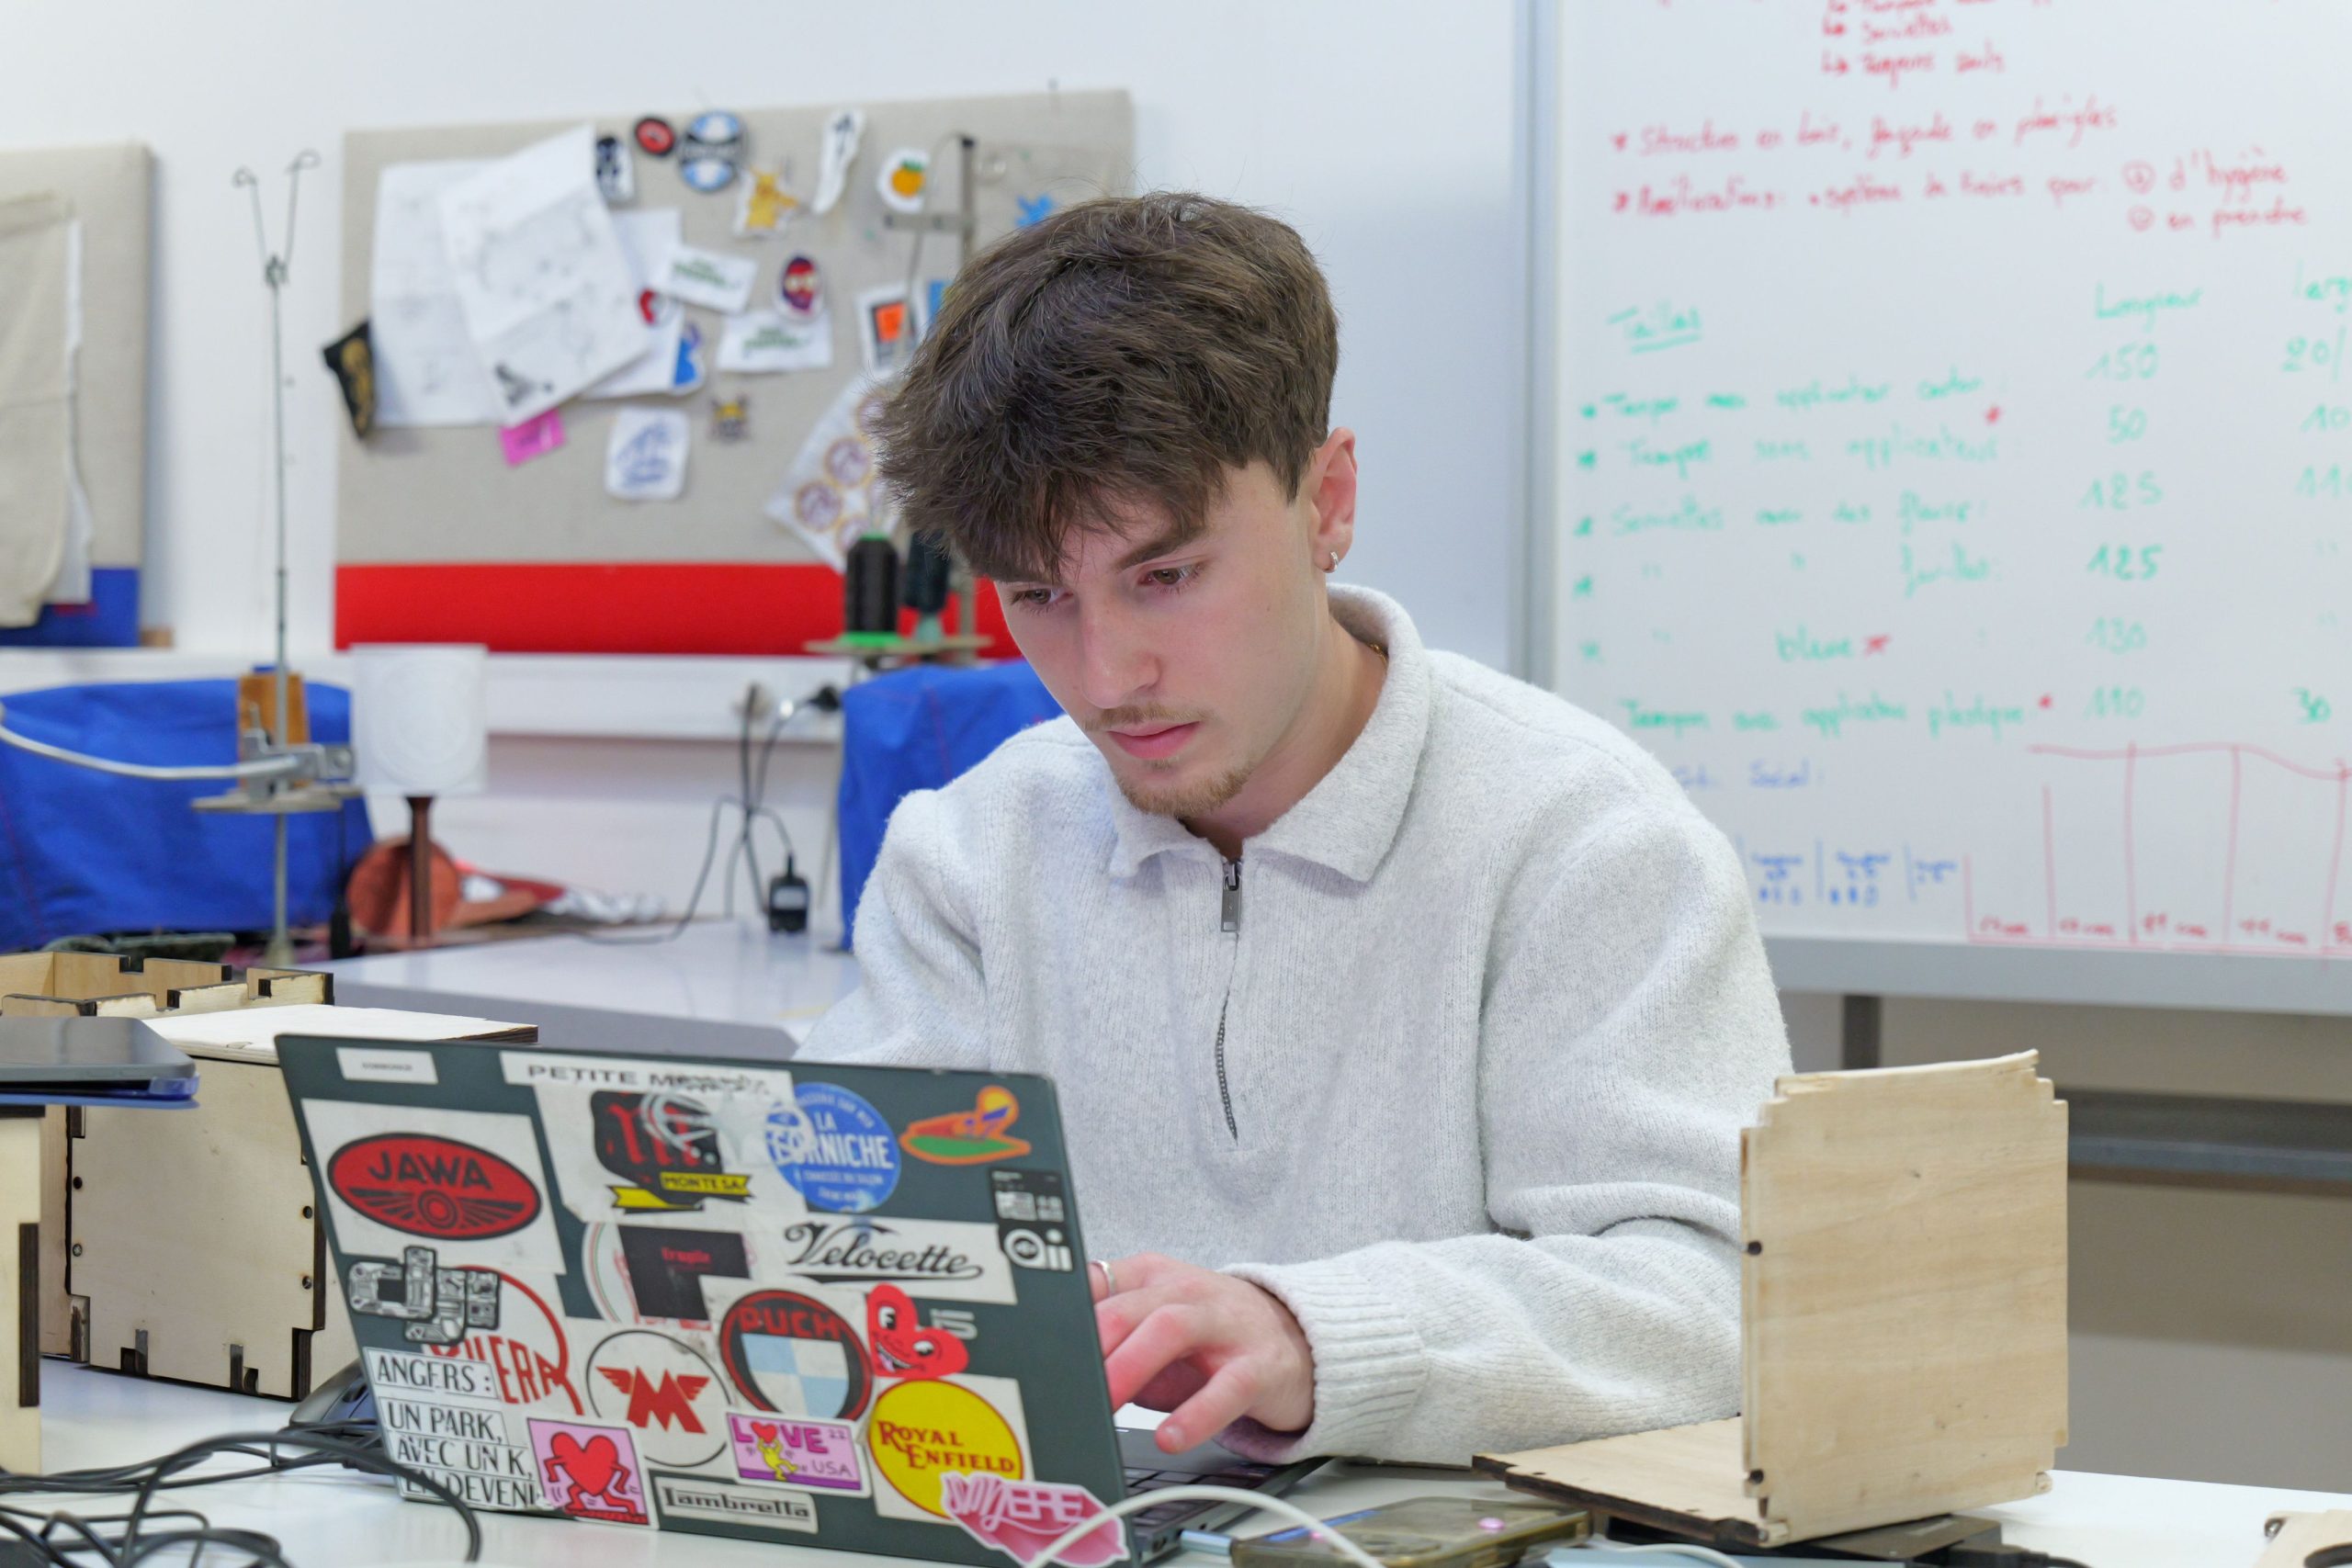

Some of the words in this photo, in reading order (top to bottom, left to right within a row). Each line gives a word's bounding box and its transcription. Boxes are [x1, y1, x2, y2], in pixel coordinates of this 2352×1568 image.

[2085, 340, 2161, 382] 150
[2106, 403, 2148, 446] 50
[2087, 543, 2165, 583] 125
[527, 1064, 638, 1085] PETITE
[814, 1111, 838, 1132] LA
[368, 1151, 493, 1190] JAWA
[785, 1222, 984, 1280] Velocette
[739, 1302, 842, 1339] PUCH
[378, 1354, 476, 1393] ANGERS
[388, 1401, 421, 1431] UN
[430, 1406, 503, 1445] PARK,
[877, 1420, 963, 1451] ROYAL
[398, 1435, 455, 1468] AVEC
[466, 1442, 500, 1472] UN
[812, 1460, 853, 1477] USA
[907, 1443, 1015, 1472] ENFIELD
